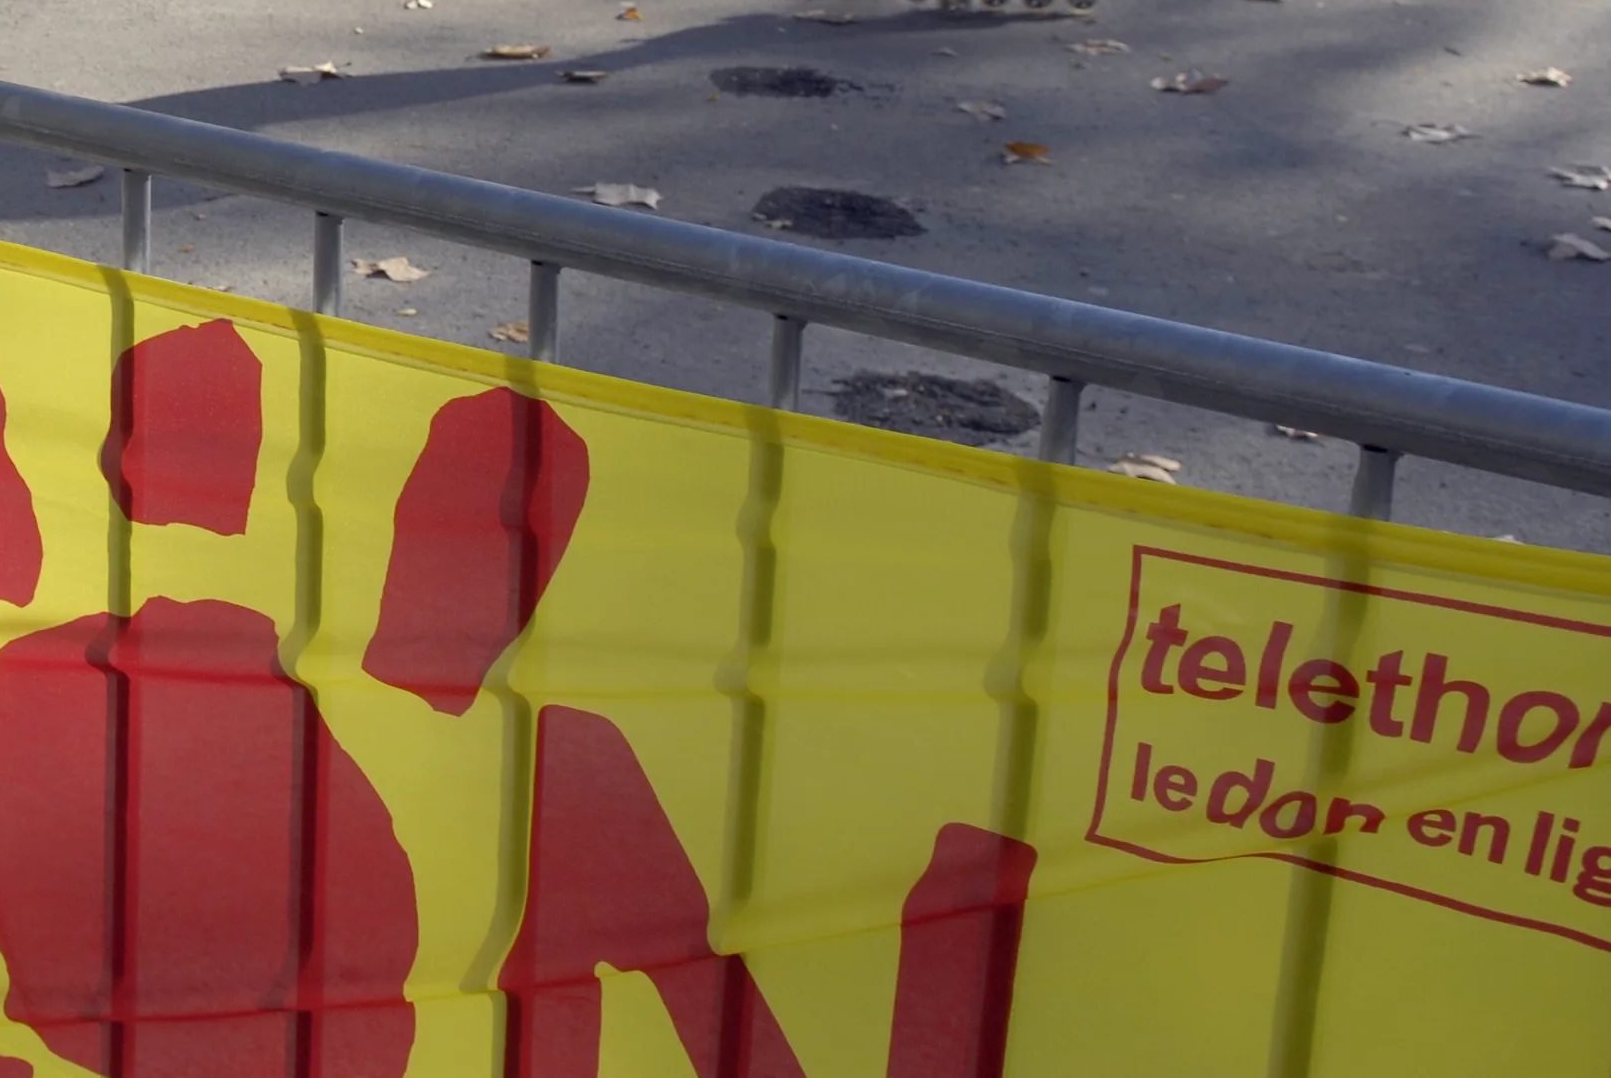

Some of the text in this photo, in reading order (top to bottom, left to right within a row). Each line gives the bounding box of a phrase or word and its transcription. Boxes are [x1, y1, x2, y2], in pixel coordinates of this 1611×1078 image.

[1130, 742, 1198, 812] le
[1205, 758, 1387, 840] don
[1406, 807, 1512, 865] en
